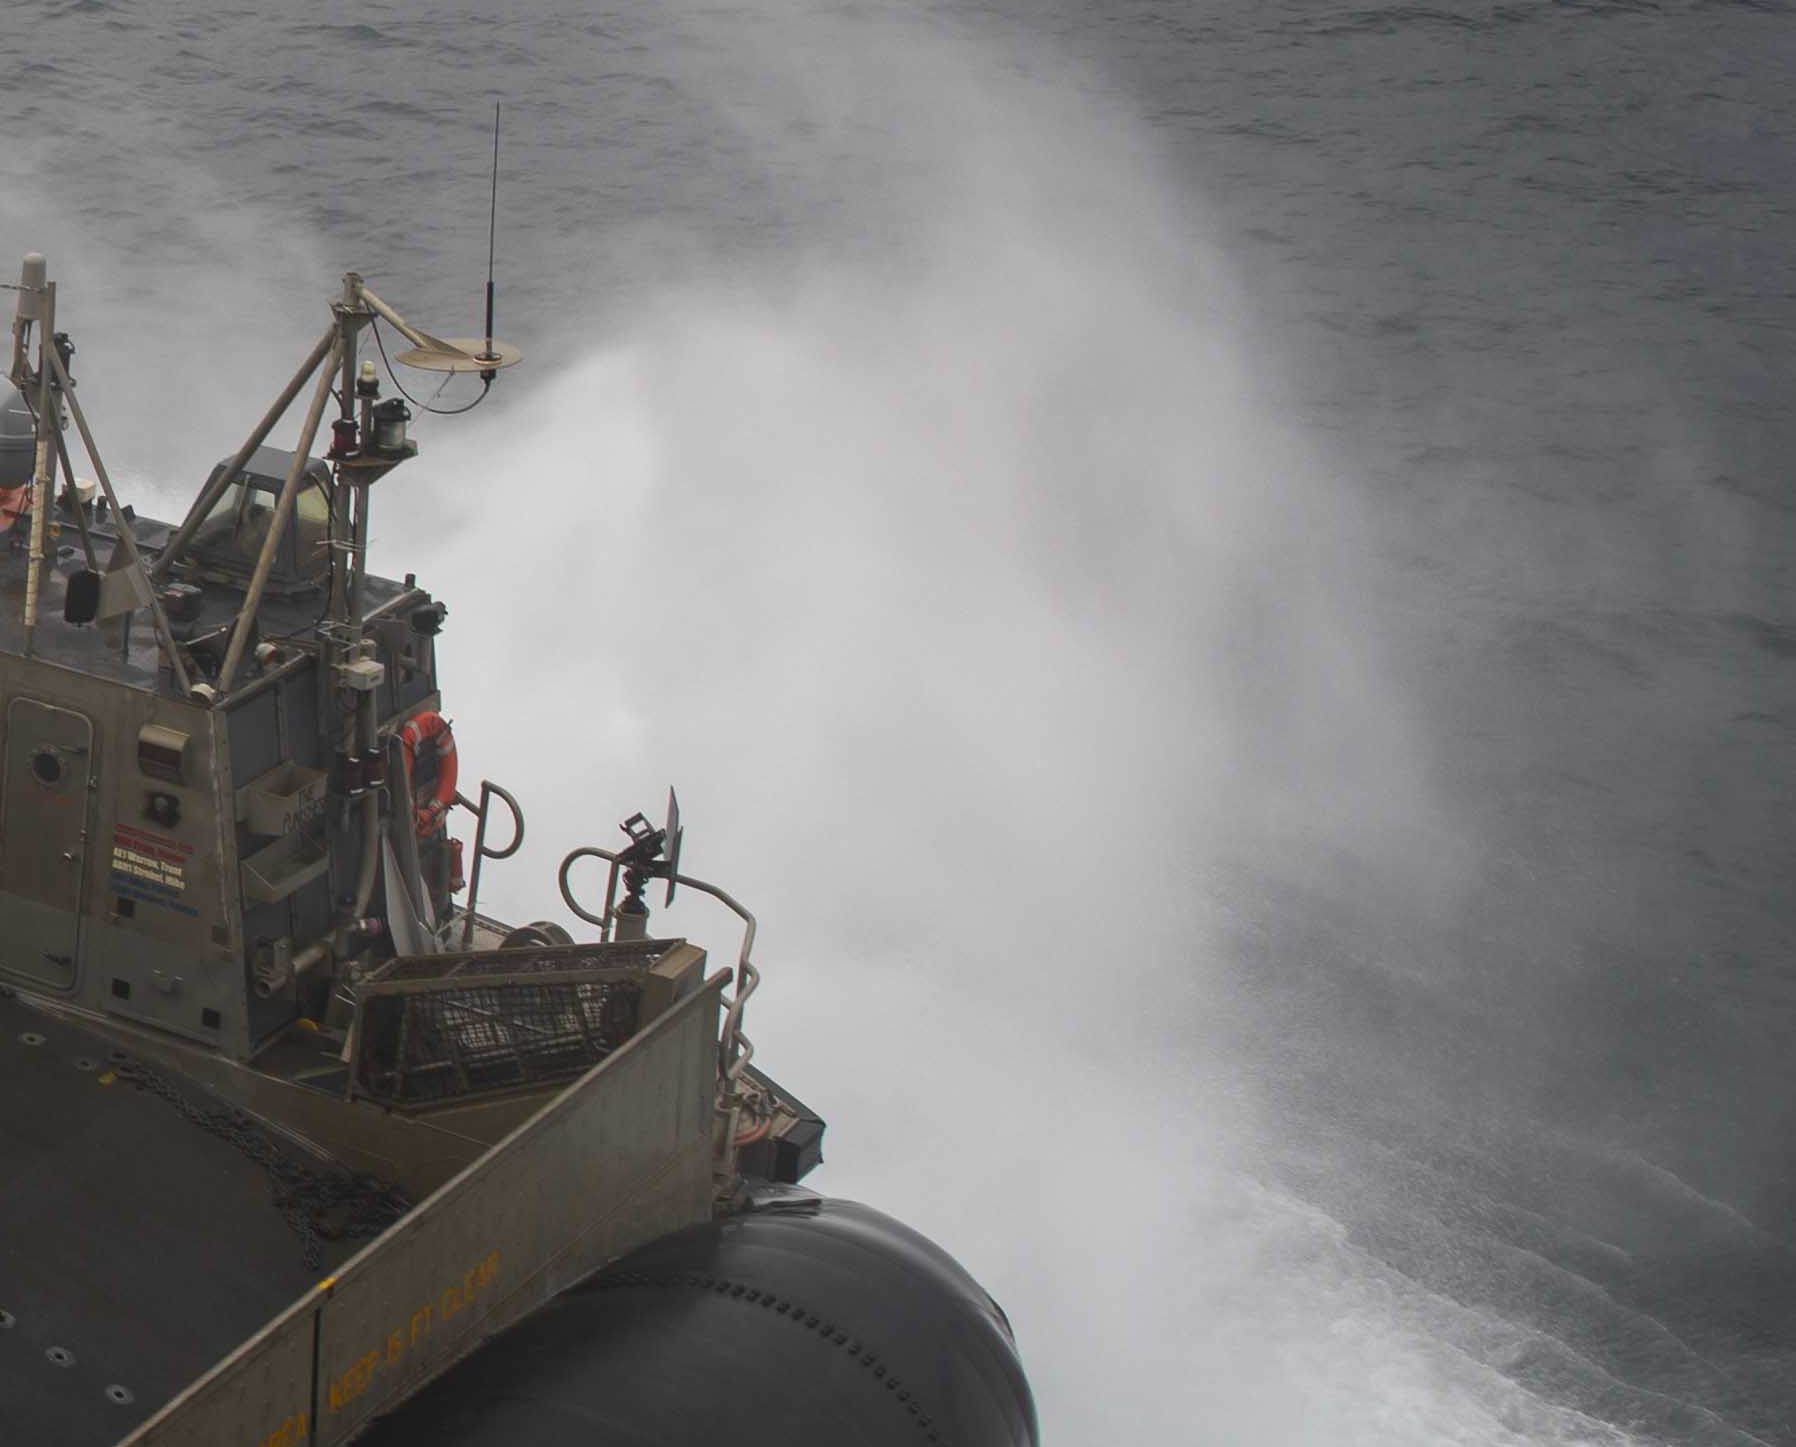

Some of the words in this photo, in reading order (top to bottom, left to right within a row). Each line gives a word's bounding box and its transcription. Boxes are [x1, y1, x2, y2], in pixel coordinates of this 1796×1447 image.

[328, 1345, 378, 1416] KEEP
[408, 1302, 435, 1346] FT
[439, 1248, 502, 1321] CLEAR
